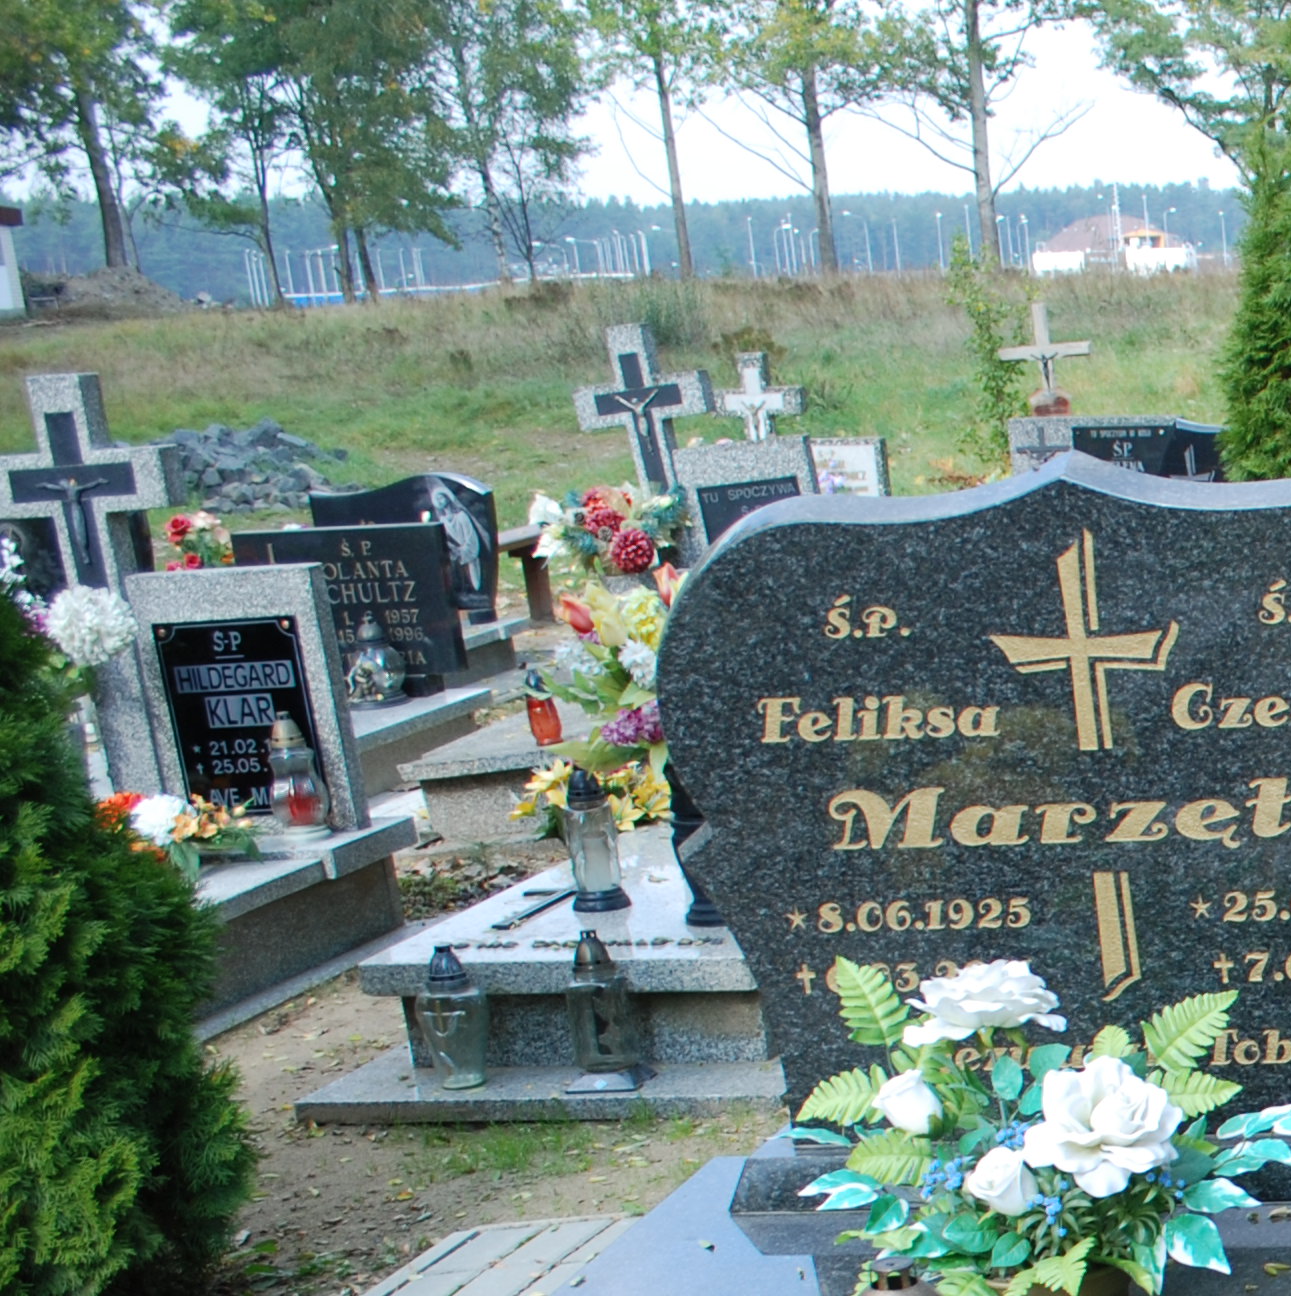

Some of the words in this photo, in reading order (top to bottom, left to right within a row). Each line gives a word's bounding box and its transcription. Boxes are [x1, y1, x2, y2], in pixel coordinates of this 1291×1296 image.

[702, 492, 719, 504] TU
[728, 483, 796, 501] SPOCZYWA
[323, 560, 409, 580] OLANTA
[328, 581, 416, 604] CHULTZ
[824, 595, 912, 640] Ś.P.
[177, 662, 291, 691] HILDEGARD
[208, 696, 273, 727] KLAR
[757, 694, 1001, 745] Feliksa
[209, 738, 273, 756] 21.02.1
[213, 758, 269, 775] 25.05.
[817, 896, 1032, 934] 8.06.1925
